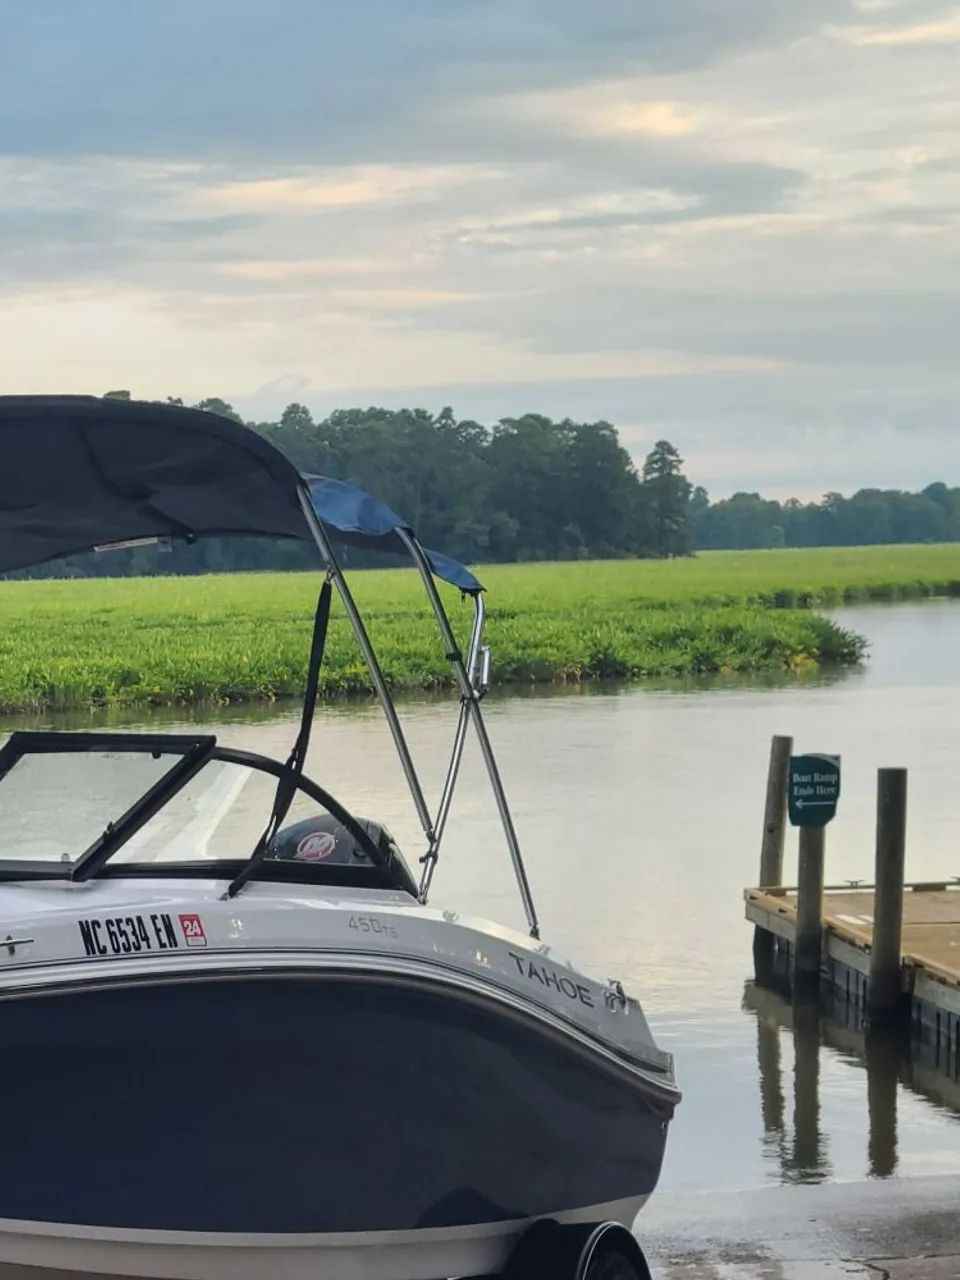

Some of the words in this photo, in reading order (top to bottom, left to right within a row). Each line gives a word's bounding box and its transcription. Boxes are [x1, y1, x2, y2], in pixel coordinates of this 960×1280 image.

[792, 773, 812, 783] Boat
[813, 772, 838, 785] Ramp
[816, 785, 836, 795] Here
[78, 919, 108, 956] NC
[105, 915, 152, 954] 6534
[150, 913, 178, 949] EN
[183, 920, 204, 937] 24
[508, 951, 596, 1008] TAHOE
